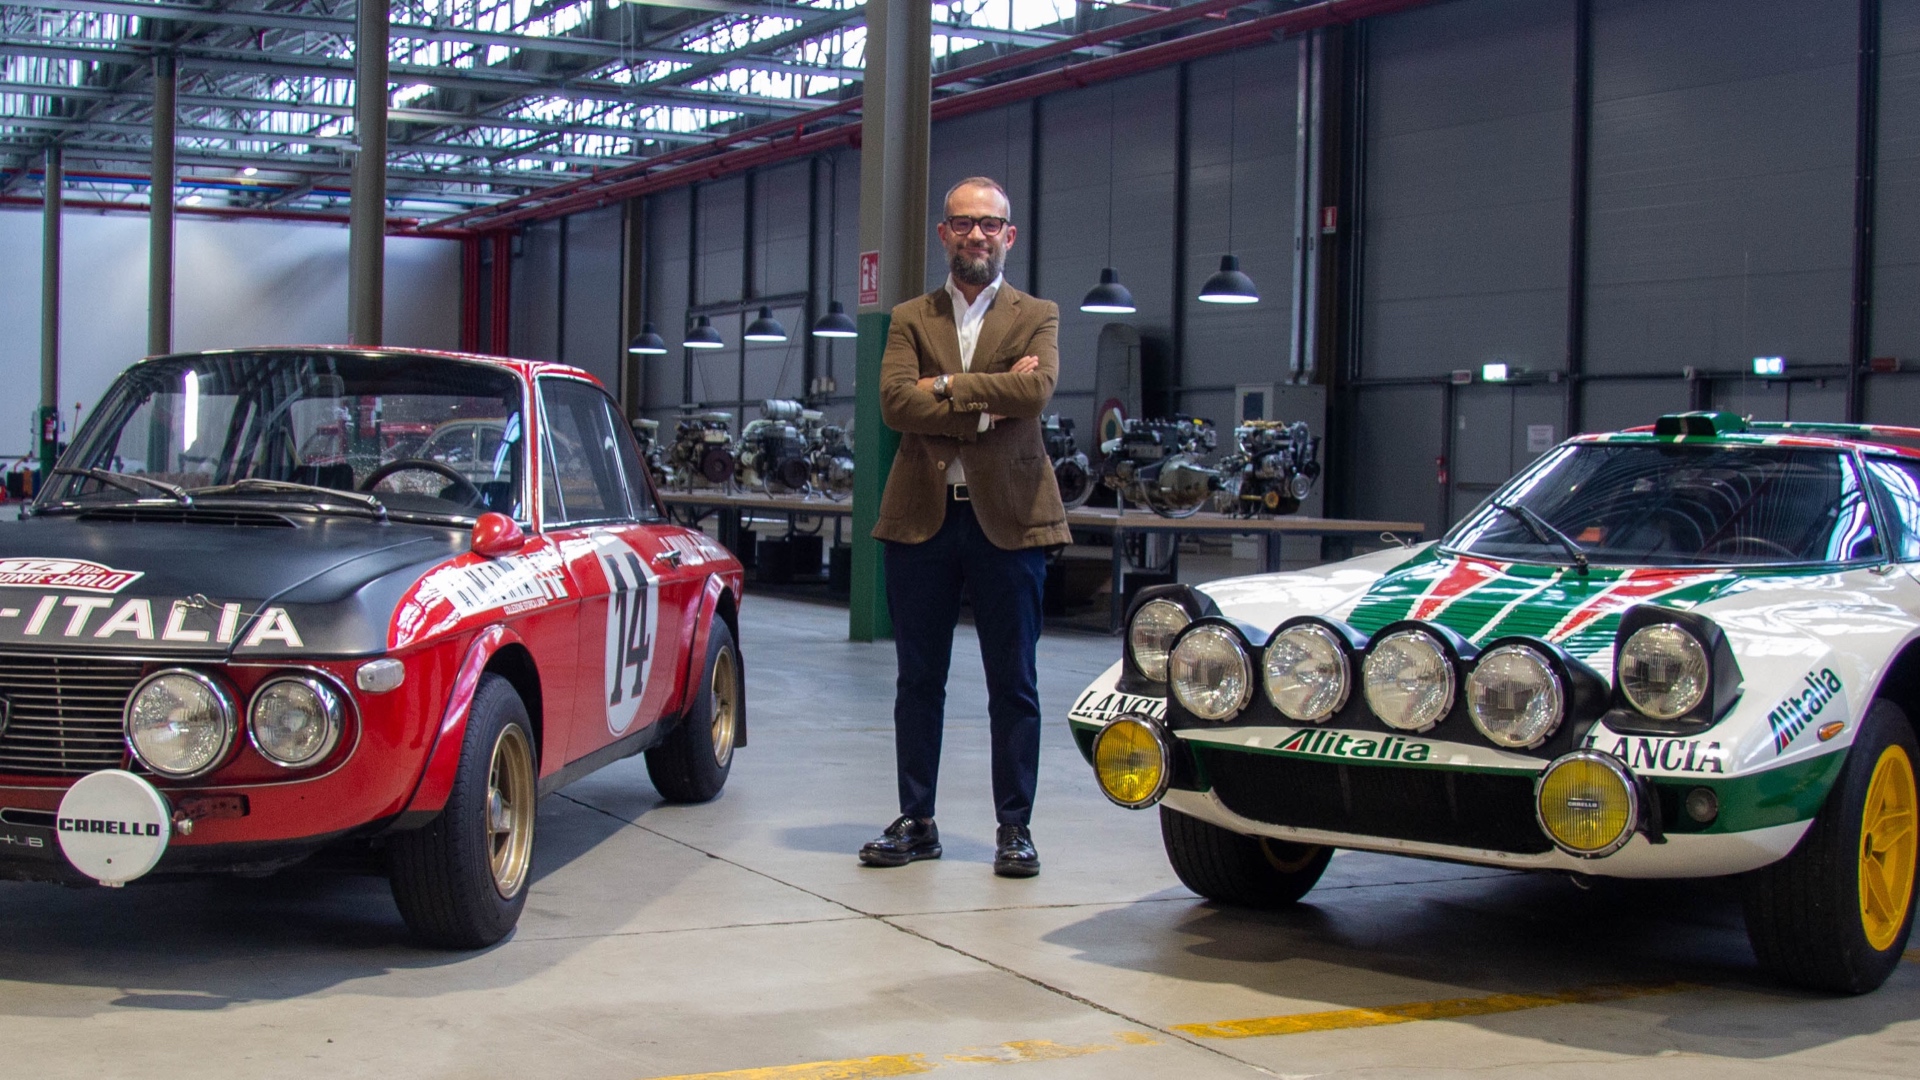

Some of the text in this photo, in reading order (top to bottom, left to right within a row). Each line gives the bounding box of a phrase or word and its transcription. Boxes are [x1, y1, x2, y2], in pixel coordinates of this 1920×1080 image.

[14, 562, 57, 572] 14
[0, 573, 125, 587] ONTE-CARLO
[604, 551, 650, 707] 14
[1767, 666, 1842, 756] Alitalia
[1274, 728, 1429, 761] Alitalia
[59, 818, 160, 836] CARELLO
